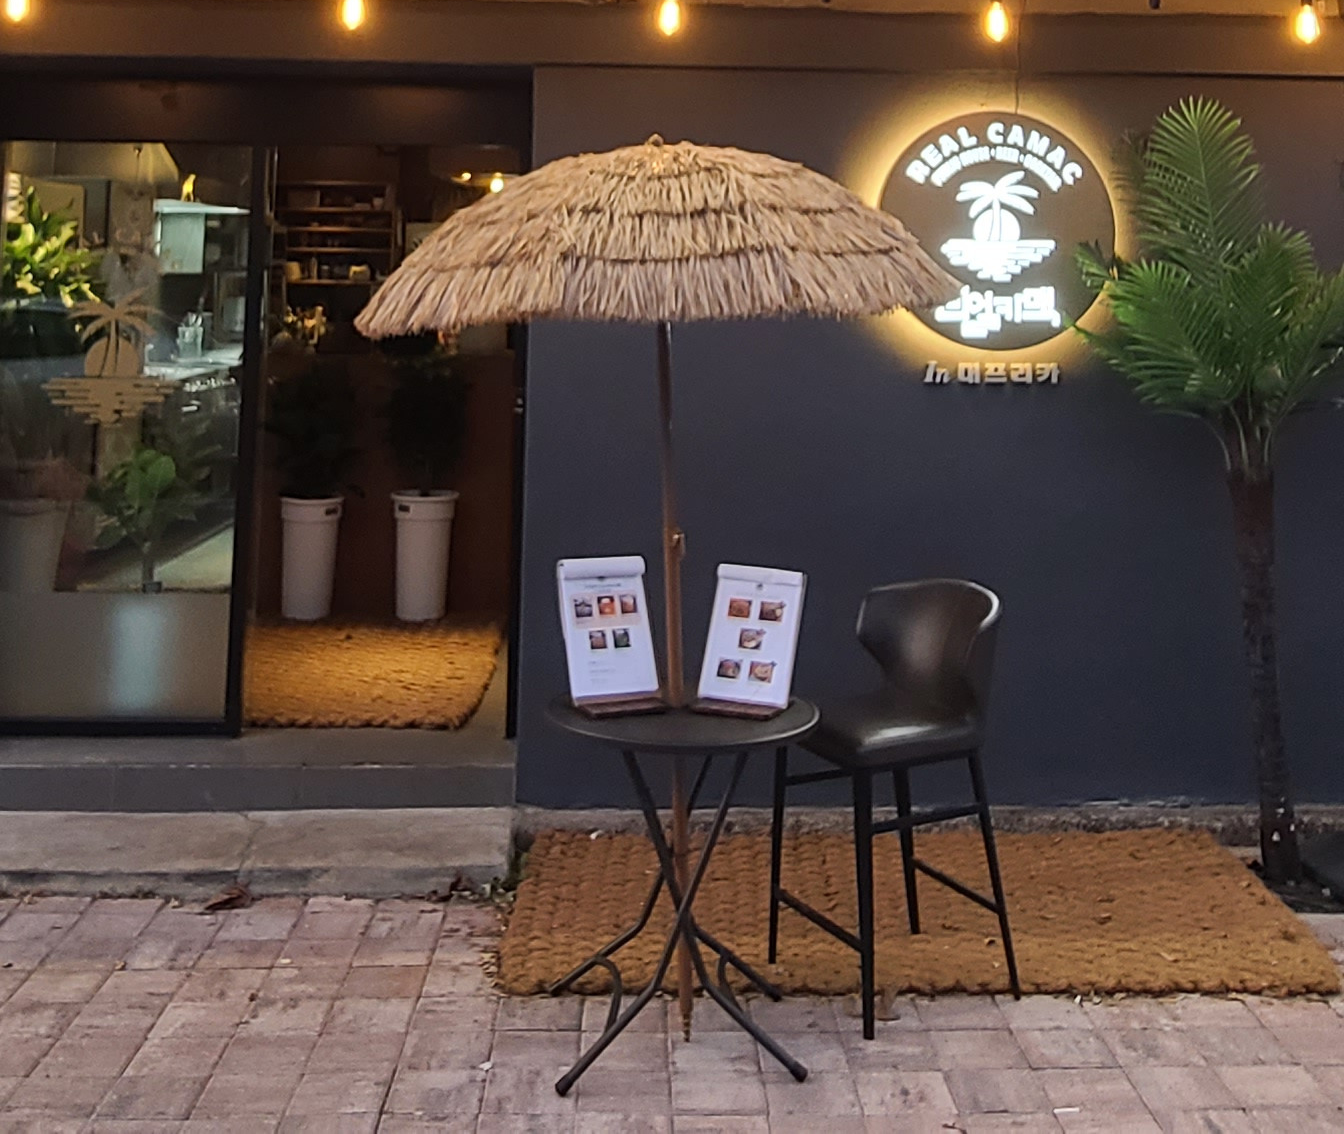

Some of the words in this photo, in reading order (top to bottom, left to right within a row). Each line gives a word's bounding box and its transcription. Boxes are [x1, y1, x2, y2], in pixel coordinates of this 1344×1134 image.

[905, 126, 978, 185] REAL
[986, 121, 1084, 186] CAMAC
[923, 360, 952, 384] In
